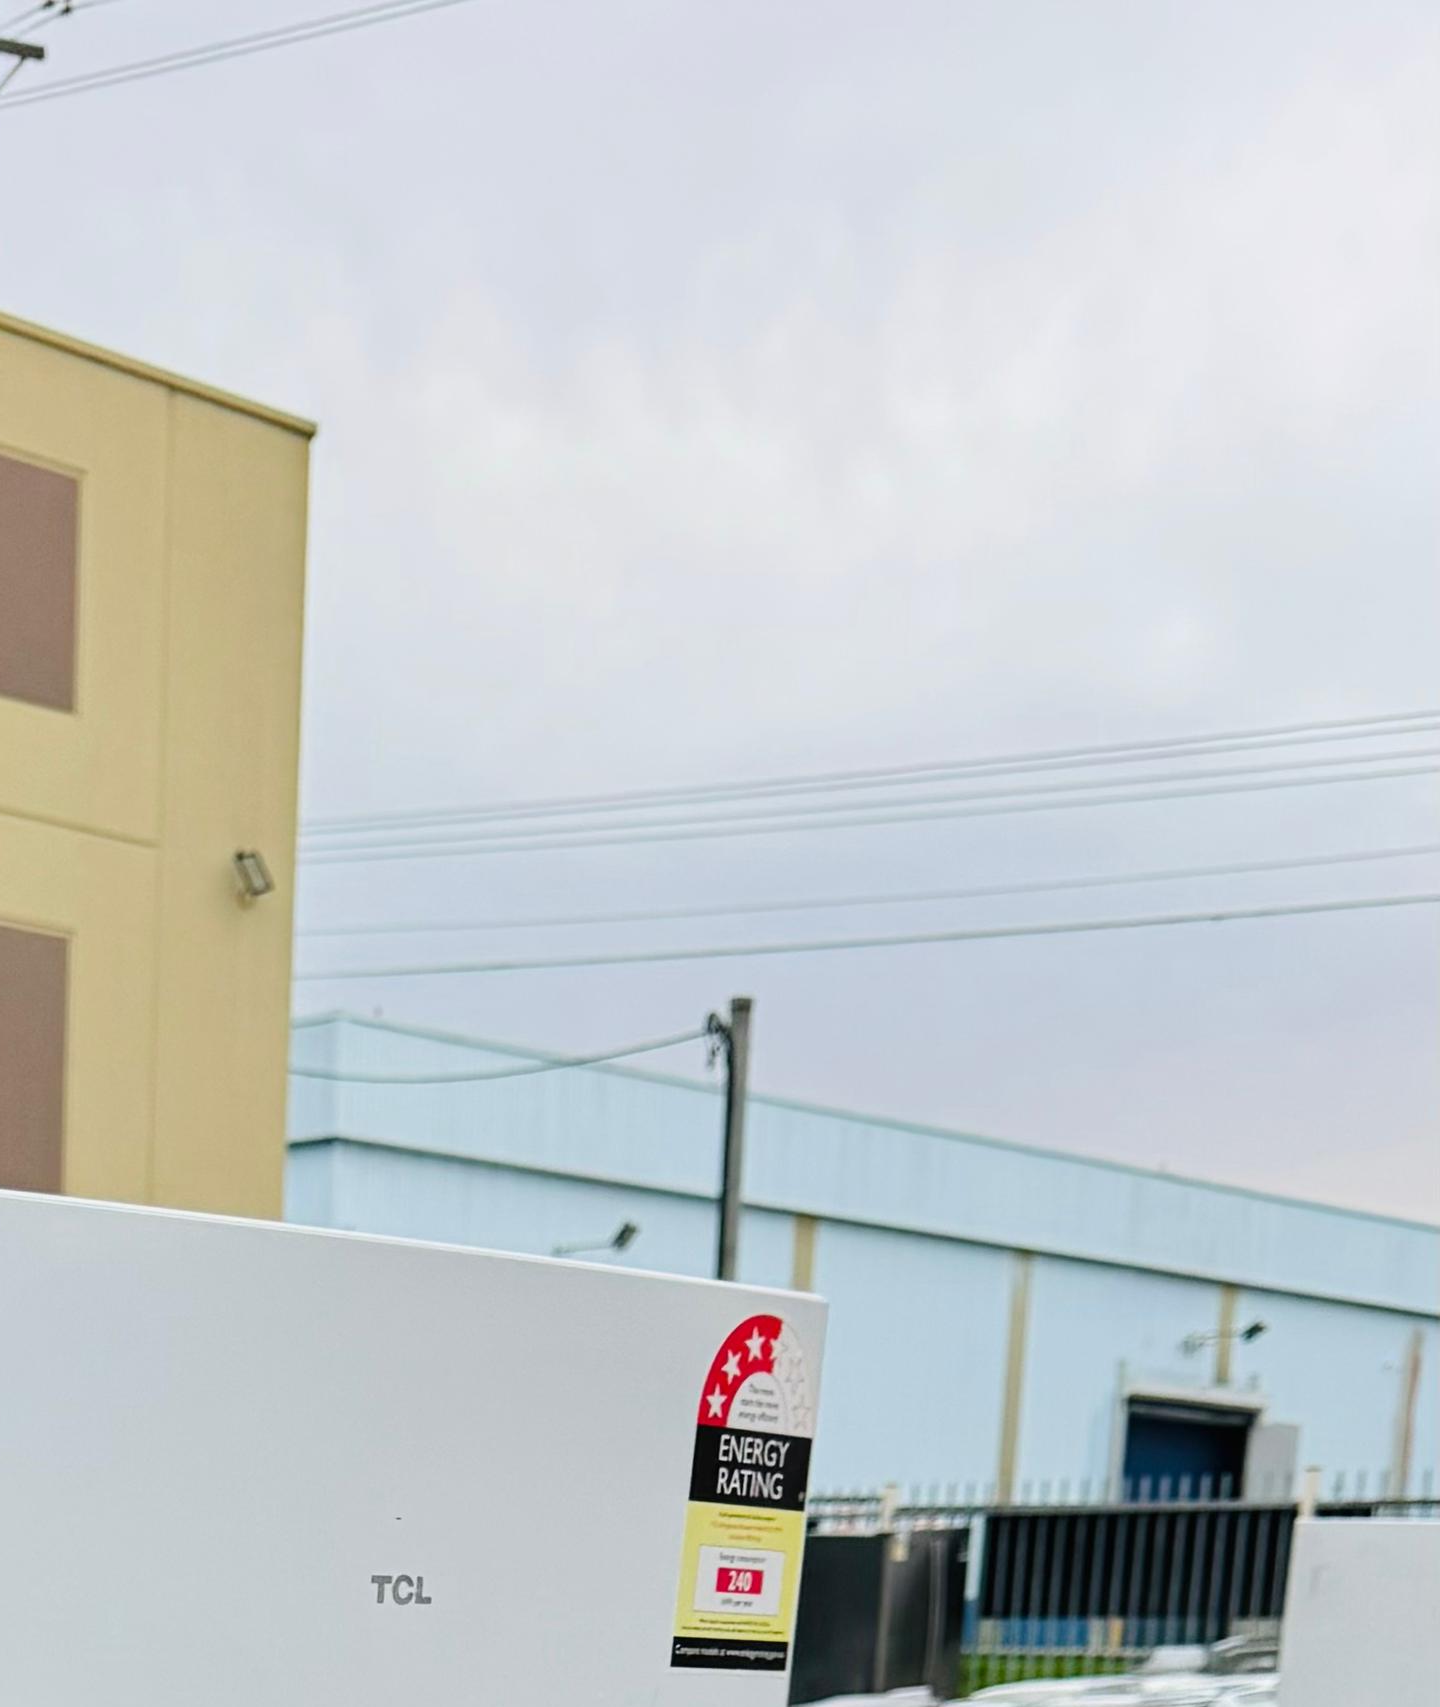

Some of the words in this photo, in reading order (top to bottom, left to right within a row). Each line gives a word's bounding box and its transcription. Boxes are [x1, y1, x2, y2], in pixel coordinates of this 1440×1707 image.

[718, 1433, 791, 1468] ENERGY
[716, 1467, 784, 1500] RATING
[371, 1574, 432, 1606] TCL
[727, 1570, 753, 1592] 240
